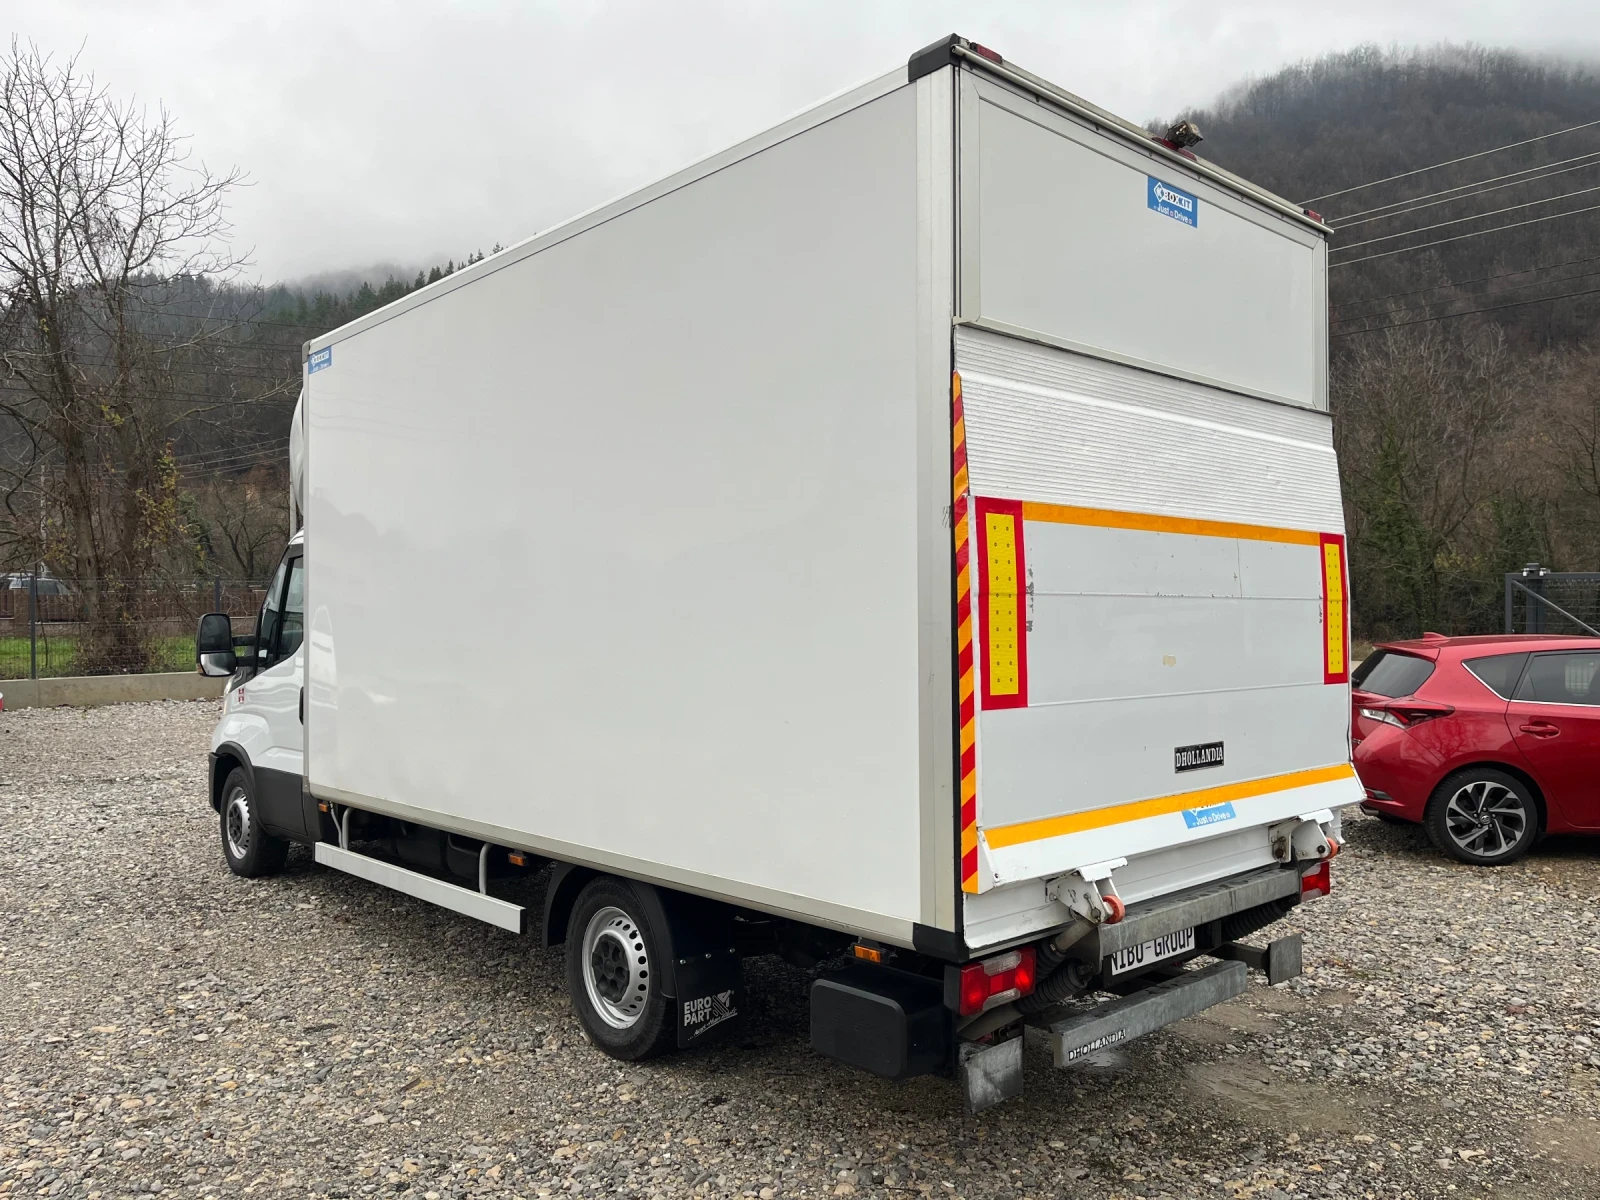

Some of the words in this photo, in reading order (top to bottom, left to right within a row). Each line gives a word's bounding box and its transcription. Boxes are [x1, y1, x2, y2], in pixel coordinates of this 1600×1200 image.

[1174, 210, 1188, 224] Drive
[1175, 746, 1224, 768] DHOLLANDIA
[684, 996, 711, 1014] EURO
[684, 1008, 711, 1026] PART
[1068, 1029, 1126, 1062] DHOLLANDIA
